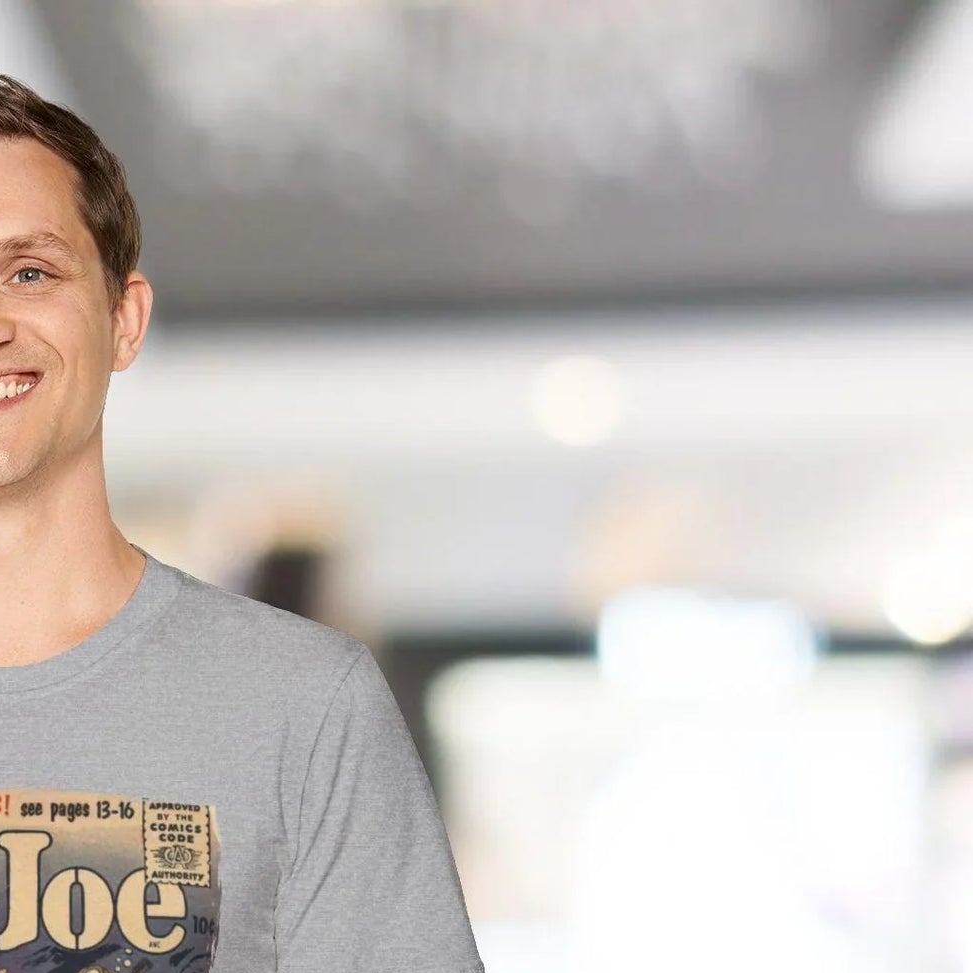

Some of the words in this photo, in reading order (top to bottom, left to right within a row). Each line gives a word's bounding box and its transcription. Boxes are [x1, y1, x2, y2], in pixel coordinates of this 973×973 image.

[20, 802, 43, 817] see
[50, 802, 90, 823] pages
[96, 800, 135, 820] 13-16
[149, 802, 201, 812] APPROVED
[157, 813, 170, 821] BY
[175, 813, 194, 821] THE
[150, 823, 202, 834] COMICS
[159, 833, 195, 843] CODE
[151, 871, 205, 881] AUTHORITY
